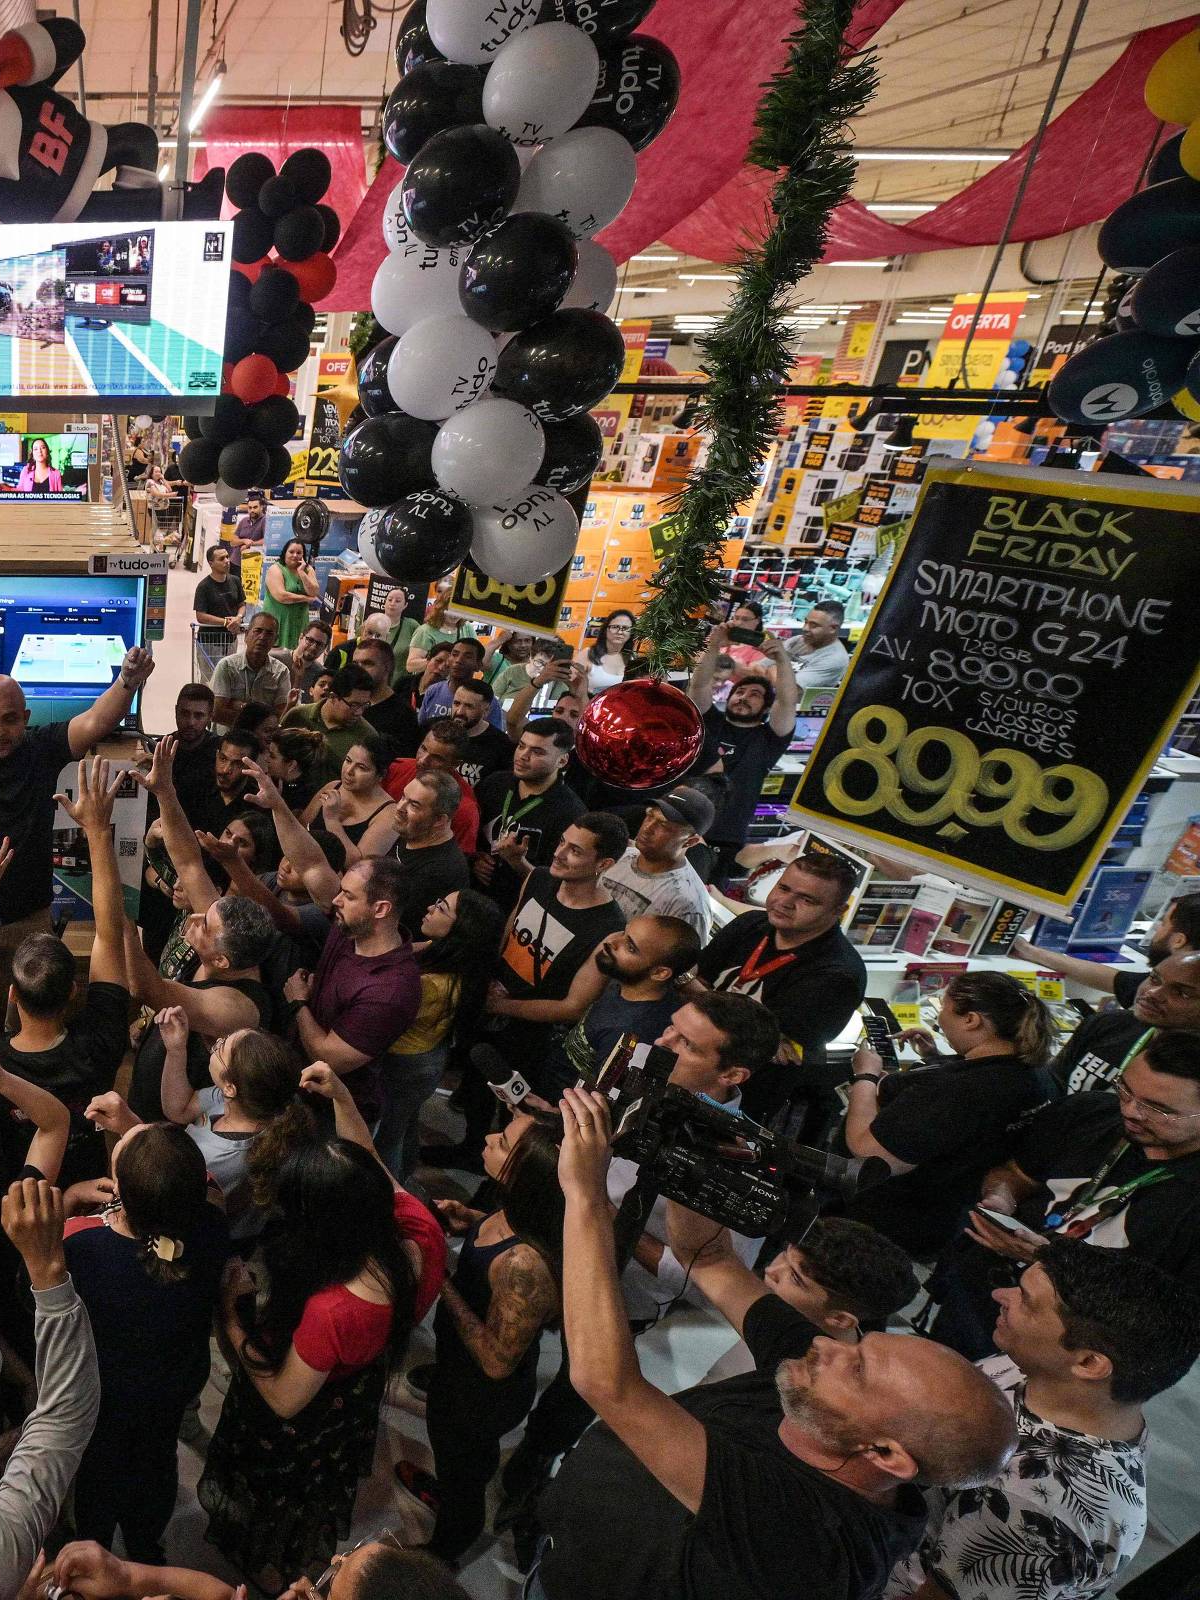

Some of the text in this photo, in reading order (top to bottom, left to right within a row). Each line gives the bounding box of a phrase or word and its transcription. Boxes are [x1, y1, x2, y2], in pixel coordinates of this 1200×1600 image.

[485, 5, 509, 26] TV
[616, 46, 643, 115] tudo
[646, 64, 662, 90] TV
[28, 103, 72, 176] BF
[522, 122, 543, 135] TV
[404, 243, 418, 258] TV
[951, 313, 1011, 330] OFERTA
[622, 332, 645, 343] FERTA
[452, 376, 468, 396] TV
[455, 356, 488, 410] tudo
[532, 399, 560, 422] tud
[406, 491, 455, 516] tudo
[407, 503, 430, 518] TV
[501, 490, 557, 531] tudo
[532, 511, 555, 532] TV
[983, 495, 1134, 544] BLACK
[118, 558, 150, 570] tudo
[967, 529, 1138, 581] FRIDAY
[914, 559, 1172, 635] SMARTPHONE
[920, 600, 1019, 642] MOTO
[960, 636, 1033, 664] 128GB
[901, 673, 961, 713] 10X
[981, 708, 1072, 740] NOSSOS
[990, 908, 1015, 943] moto
[1000, 906, 1026, 945] friday
[1079, 1051, 1121, 1083] FELI
